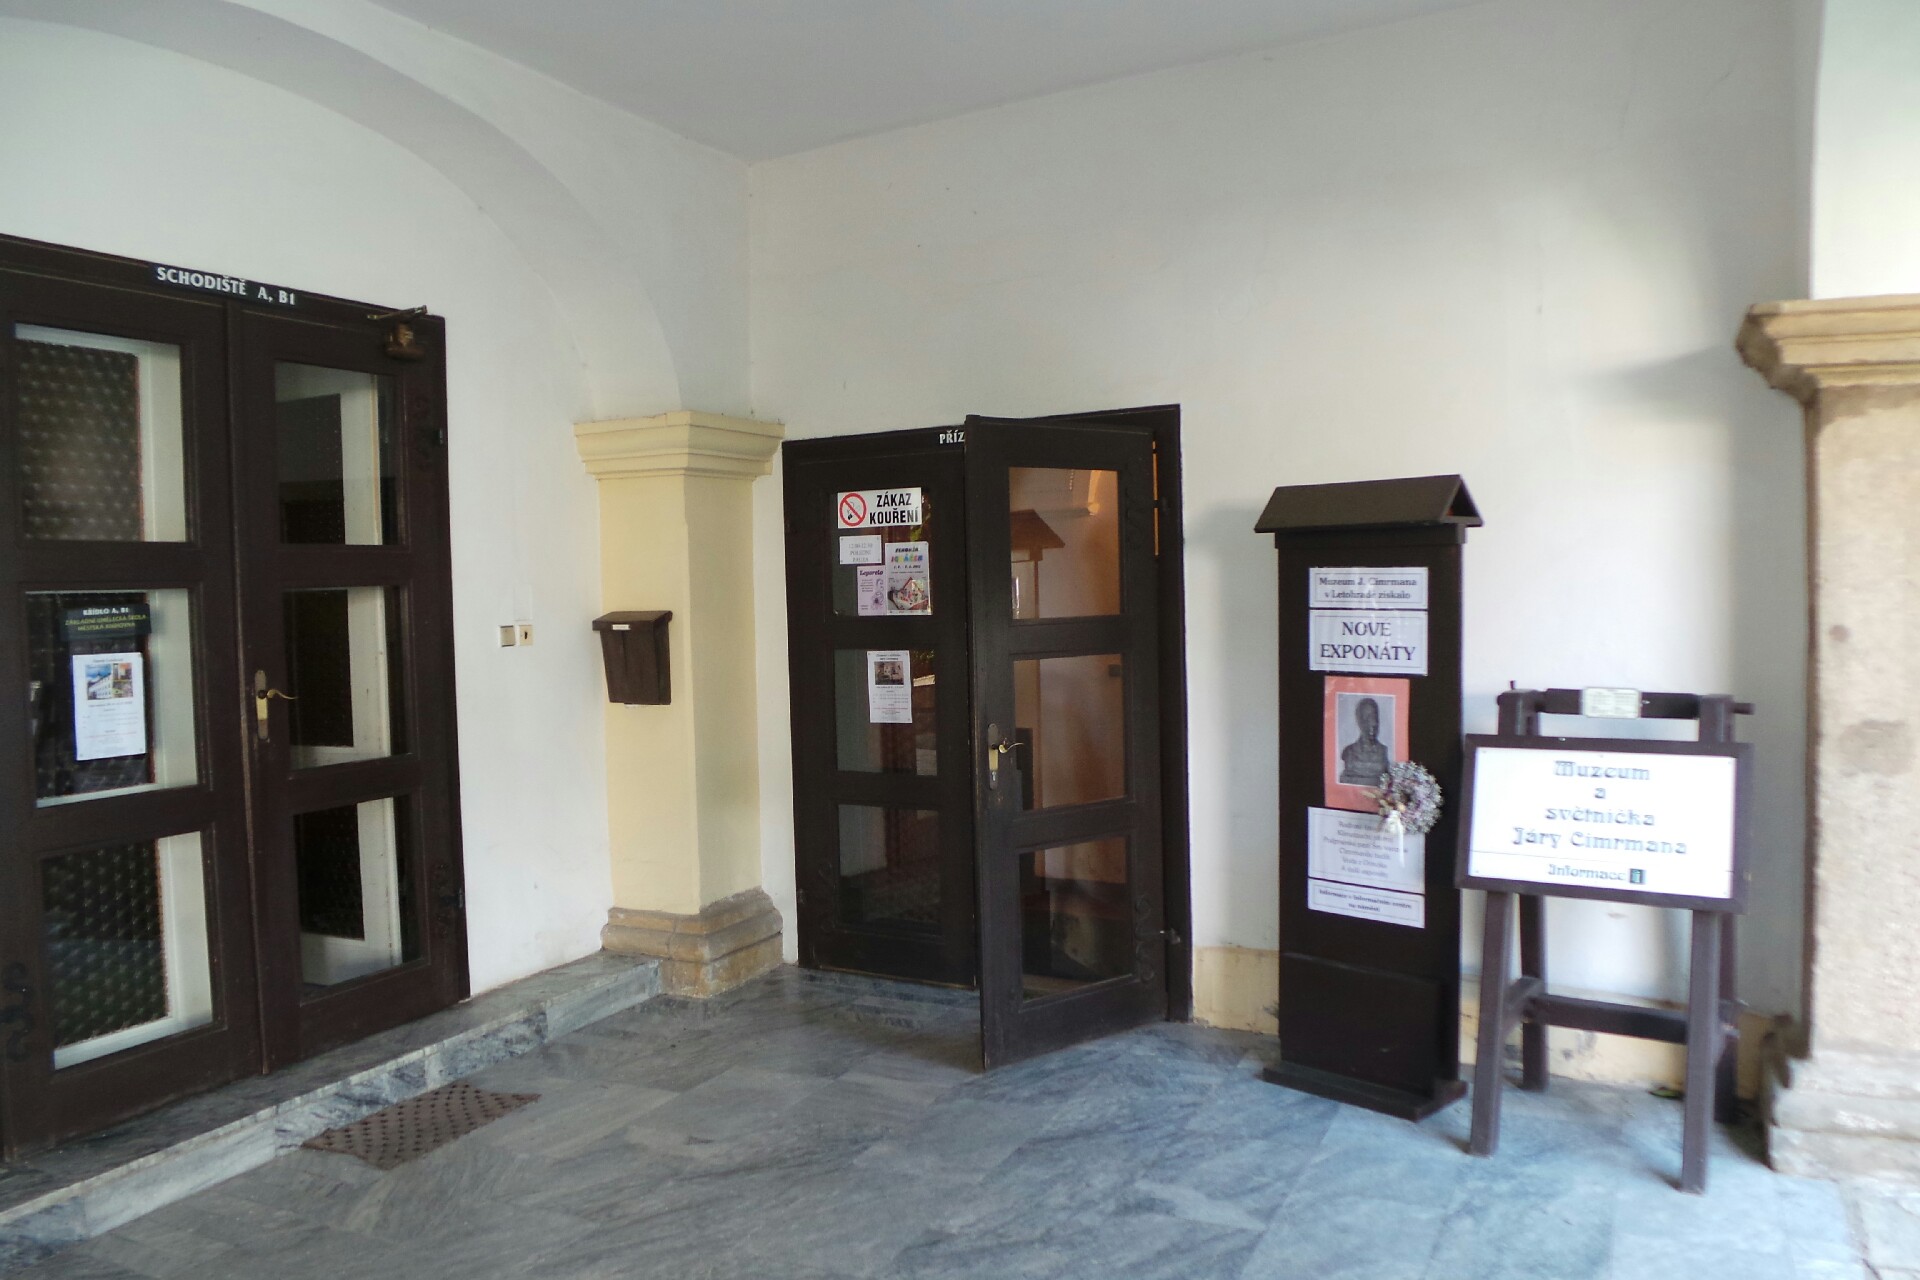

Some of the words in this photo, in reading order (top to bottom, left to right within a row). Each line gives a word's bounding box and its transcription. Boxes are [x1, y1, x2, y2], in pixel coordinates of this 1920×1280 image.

[157, 266, 247, 296] SCHODIŠTĚ
[258, 286, 273, 303] A,
[876, 491, 912, 508] ZÁKAZ
[869, 507, 919, 525] KOUŘENÍ
[1319, 577, 1356, 586] Muzeum
[1369, 577, 1417, 586] Cimrmana
[1342, 619, 1392, 637] NOVÉ
[1320, 641, 1416, 661] EXPONÁTY
[1553, 760, 1651, 781] Muzeum
[1593, 786, 1606, 800] a
[1544, 805, 1656, 827] světnička
[1512, 826, 1562, 849] Járy
[1569, 831, 1688, 855] Cimrmana
[1547, 864, 1626, 882] Informace
